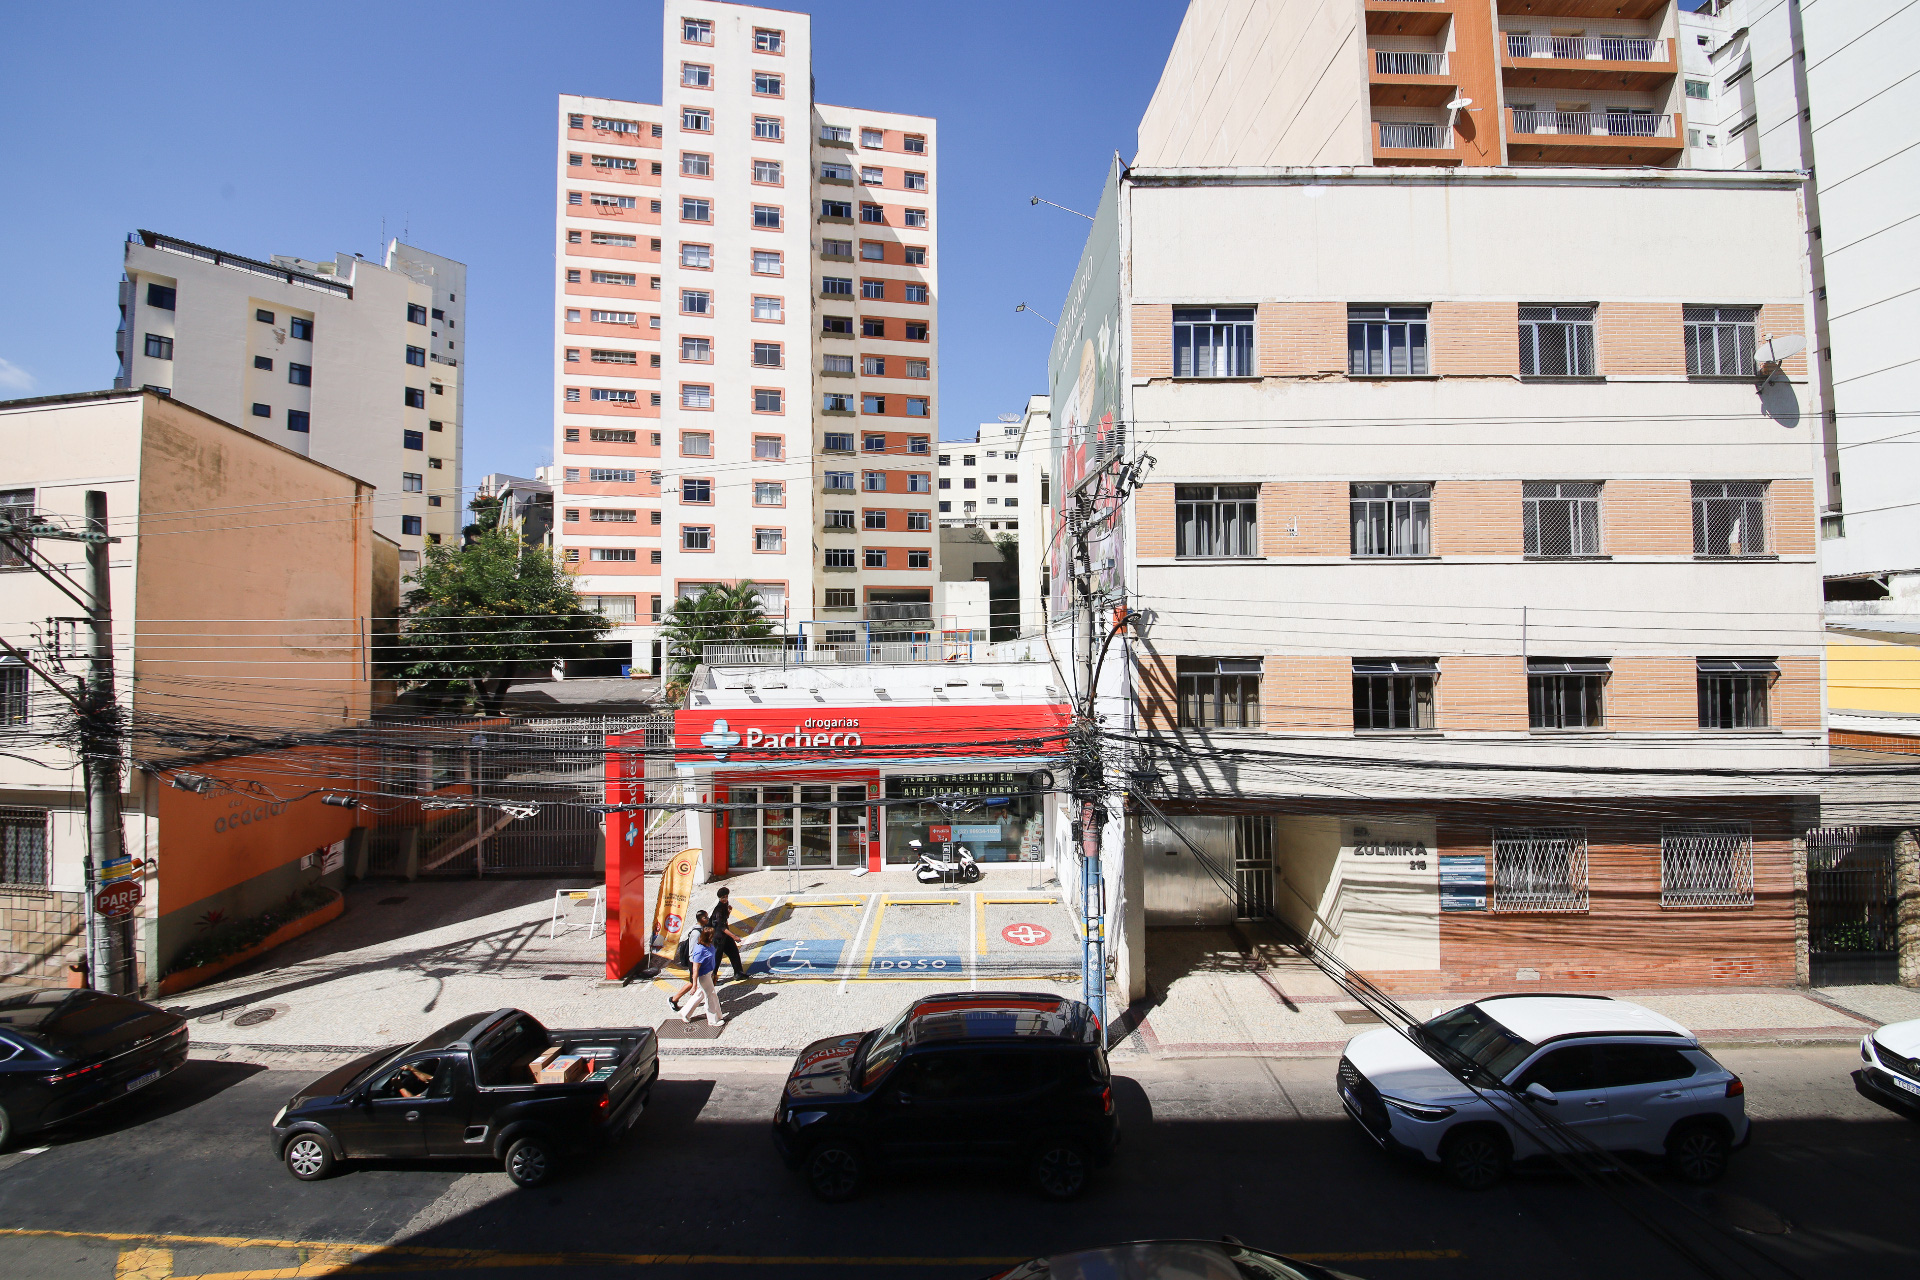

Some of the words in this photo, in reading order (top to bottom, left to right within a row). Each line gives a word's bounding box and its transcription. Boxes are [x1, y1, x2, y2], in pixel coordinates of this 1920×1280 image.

[804, 717, 859, 730] drogarias
[746, 726, 862, 752] Pacheco
[904, 786, 924, 796] ATÉ
[1353, 841, 1427, 856] ZULMIRA
[100, 888, 139, 908] PARE
[871, 959, 947, 970] IDOSO
